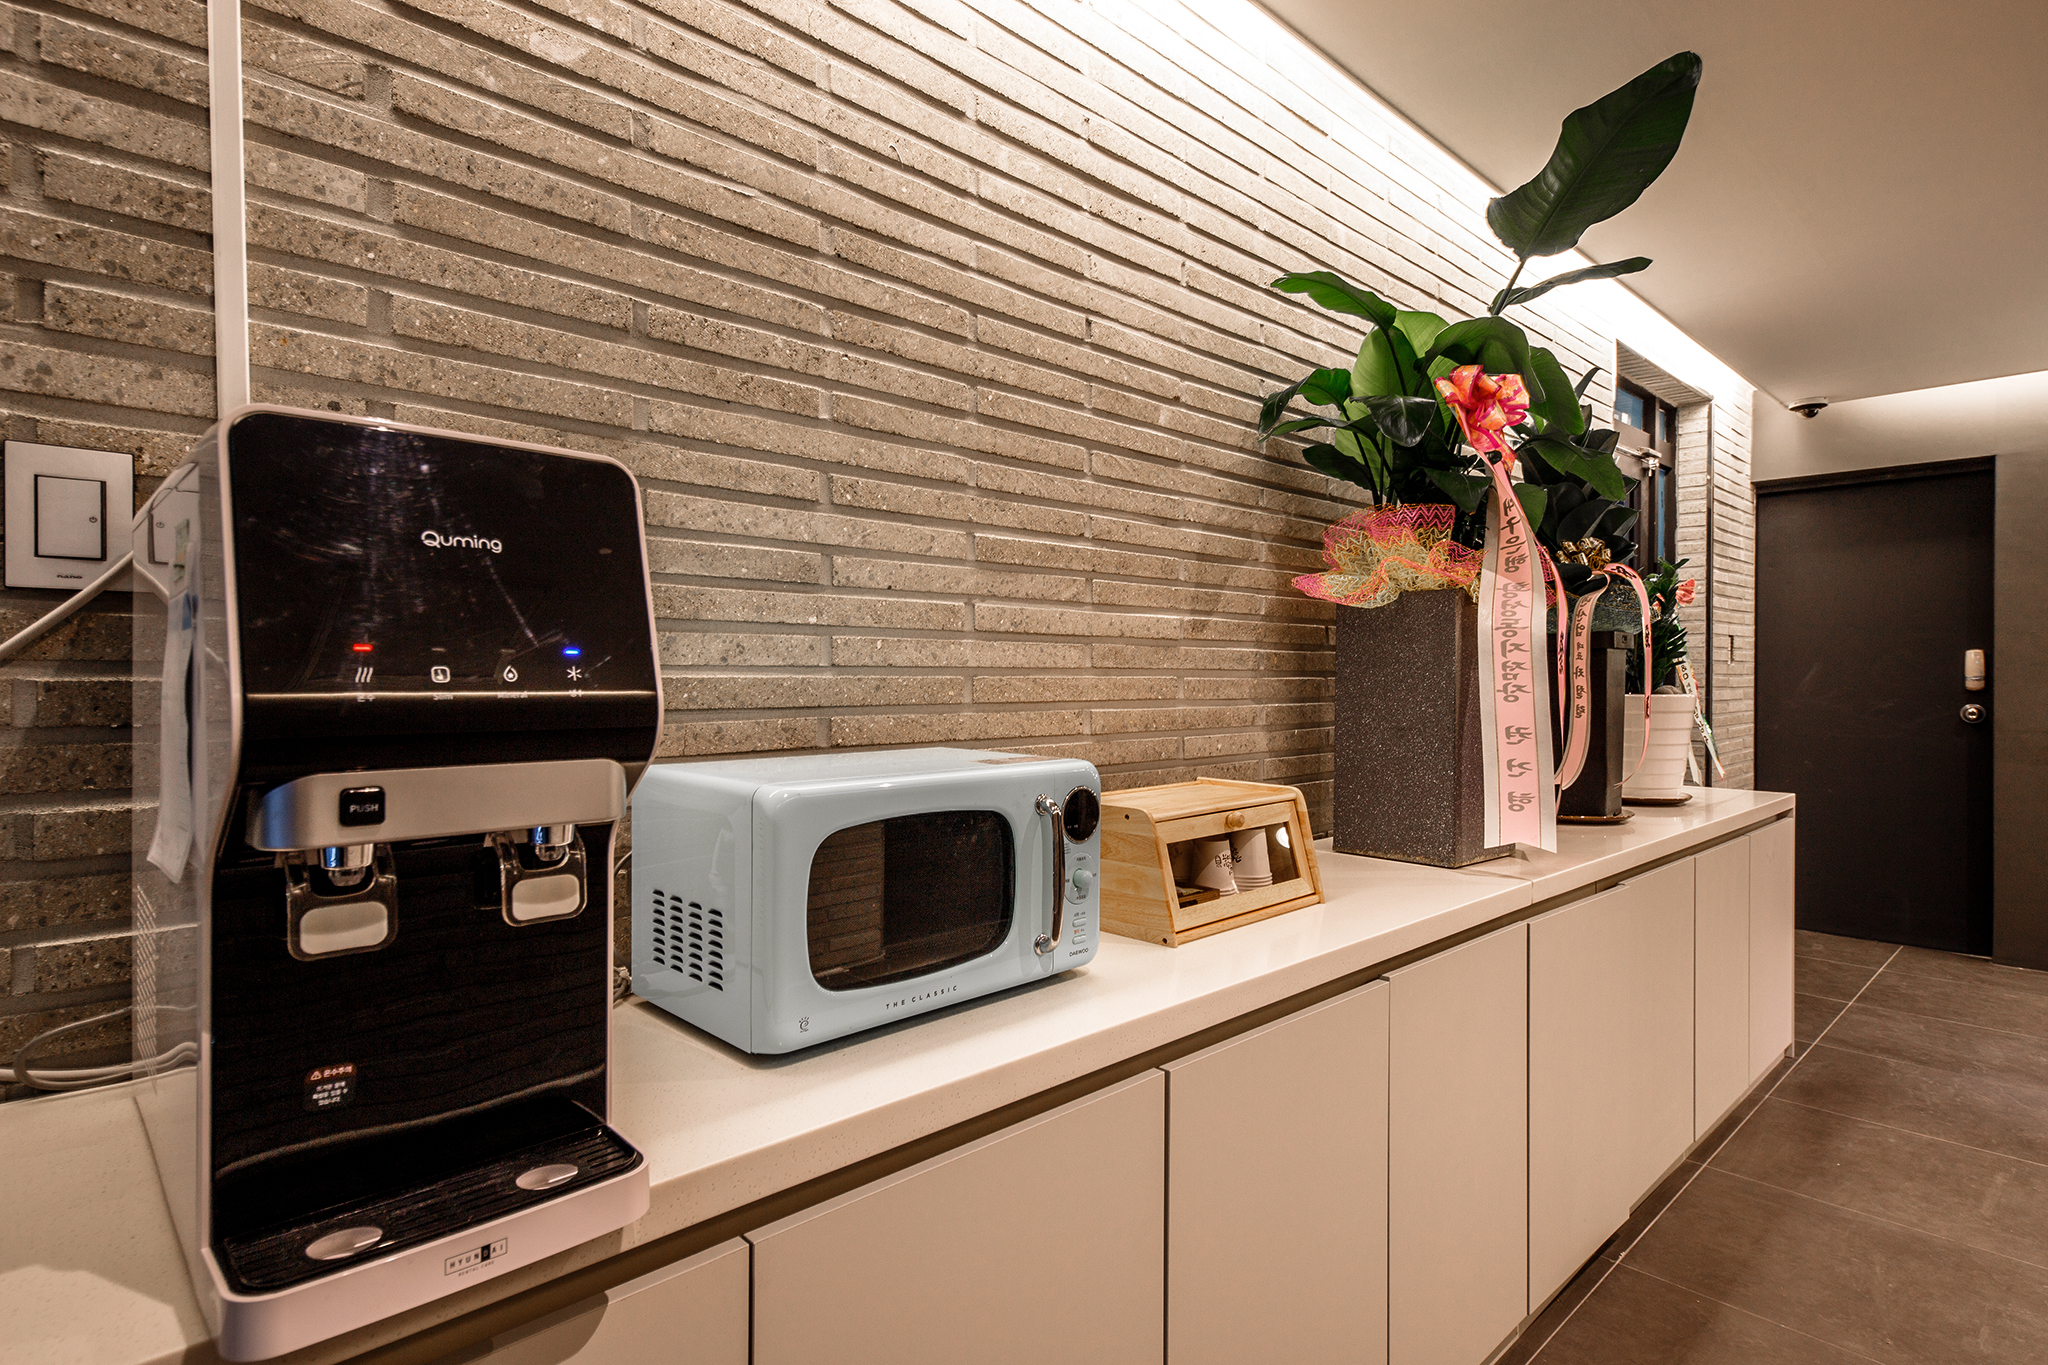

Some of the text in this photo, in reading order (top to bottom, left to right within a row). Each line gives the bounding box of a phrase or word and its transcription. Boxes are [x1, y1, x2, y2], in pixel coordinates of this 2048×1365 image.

[421, 530, 503, 553] Quming
[349, 803, 379, 813] PUSH
[1069, 947, 1089, 957] DAEWOO
[886, 985, 958, 1010] THE CLASSIC
[449, 1244, 504, 1269] HYUNDAI
